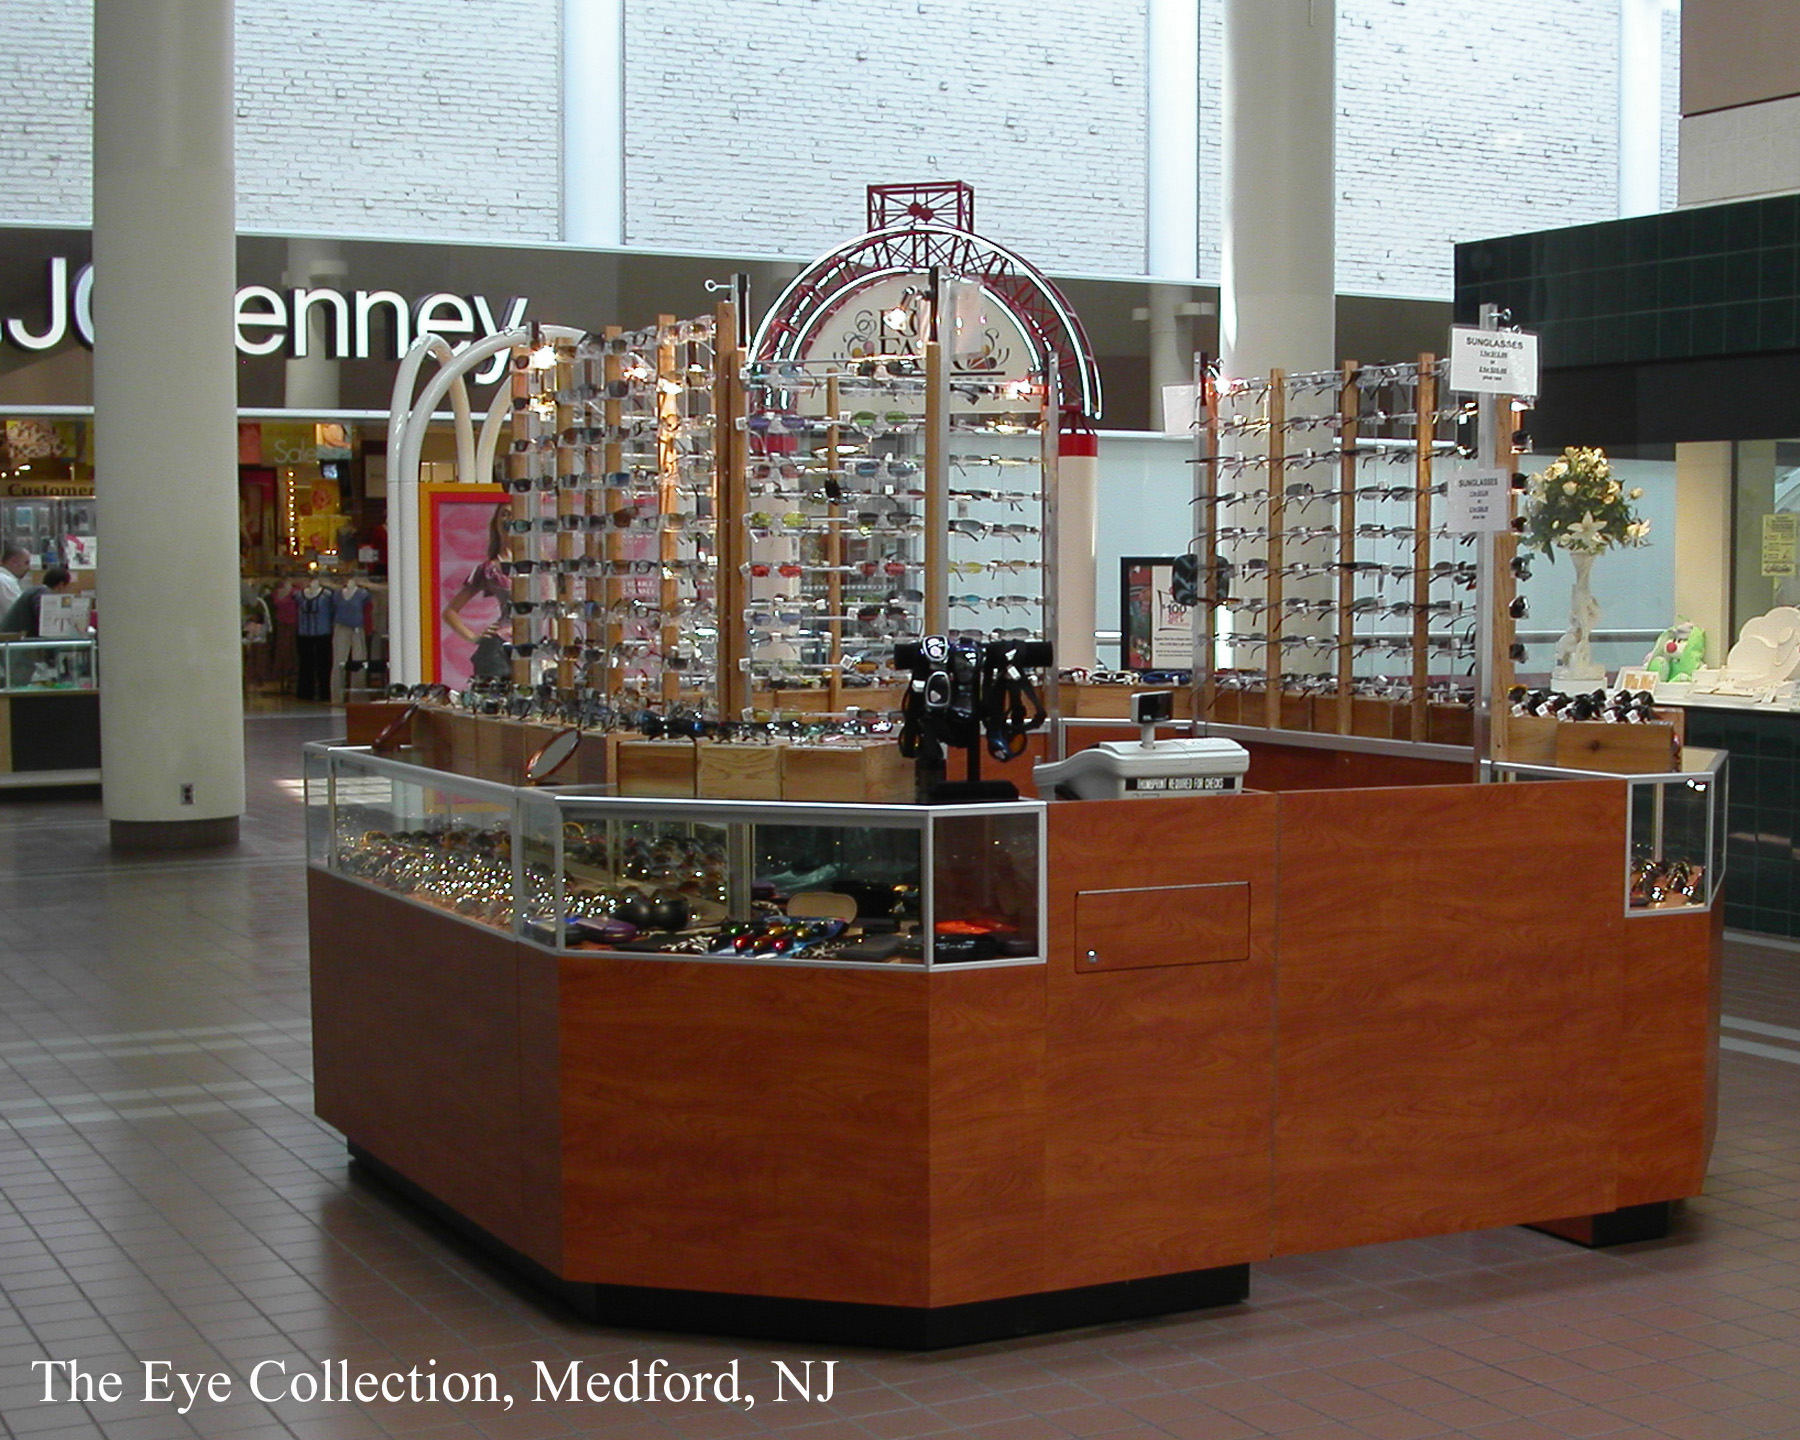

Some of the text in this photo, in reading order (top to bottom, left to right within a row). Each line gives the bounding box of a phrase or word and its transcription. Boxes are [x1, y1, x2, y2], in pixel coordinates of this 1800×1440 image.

[1466, 336, 1524, 350] SUNGLASSES
[274, 440, 319, 463] Sale
[7, 482, 96, 497] Customer
[1459, 477, 1498, 488] SUNGLASSES
[1193, 777, 1204, 790] FOR
[1204, 776, 1224, 790] CHECKS
